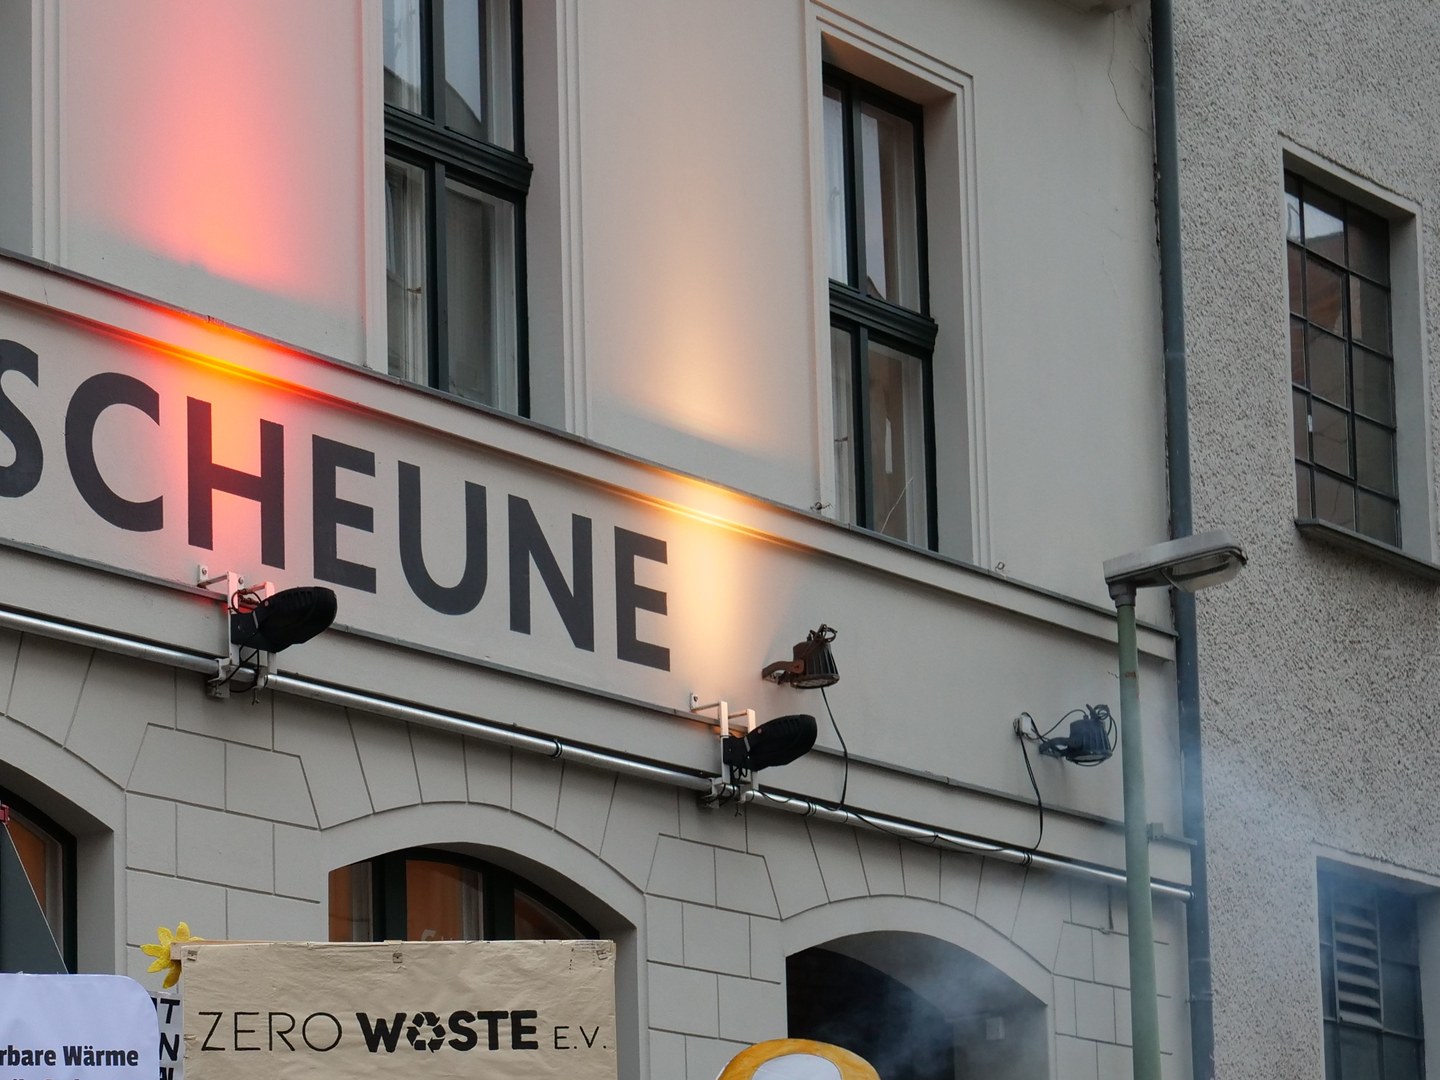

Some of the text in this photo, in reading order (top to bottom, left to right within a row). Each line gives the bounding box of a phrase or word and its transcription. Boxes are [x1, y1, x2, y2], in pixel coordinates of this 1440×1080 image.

[198, 1011, 343, 1053] ZERO
[553, 1025, 608, 1051] E.V.
[63, 1045, 139, 1067] Wärme
